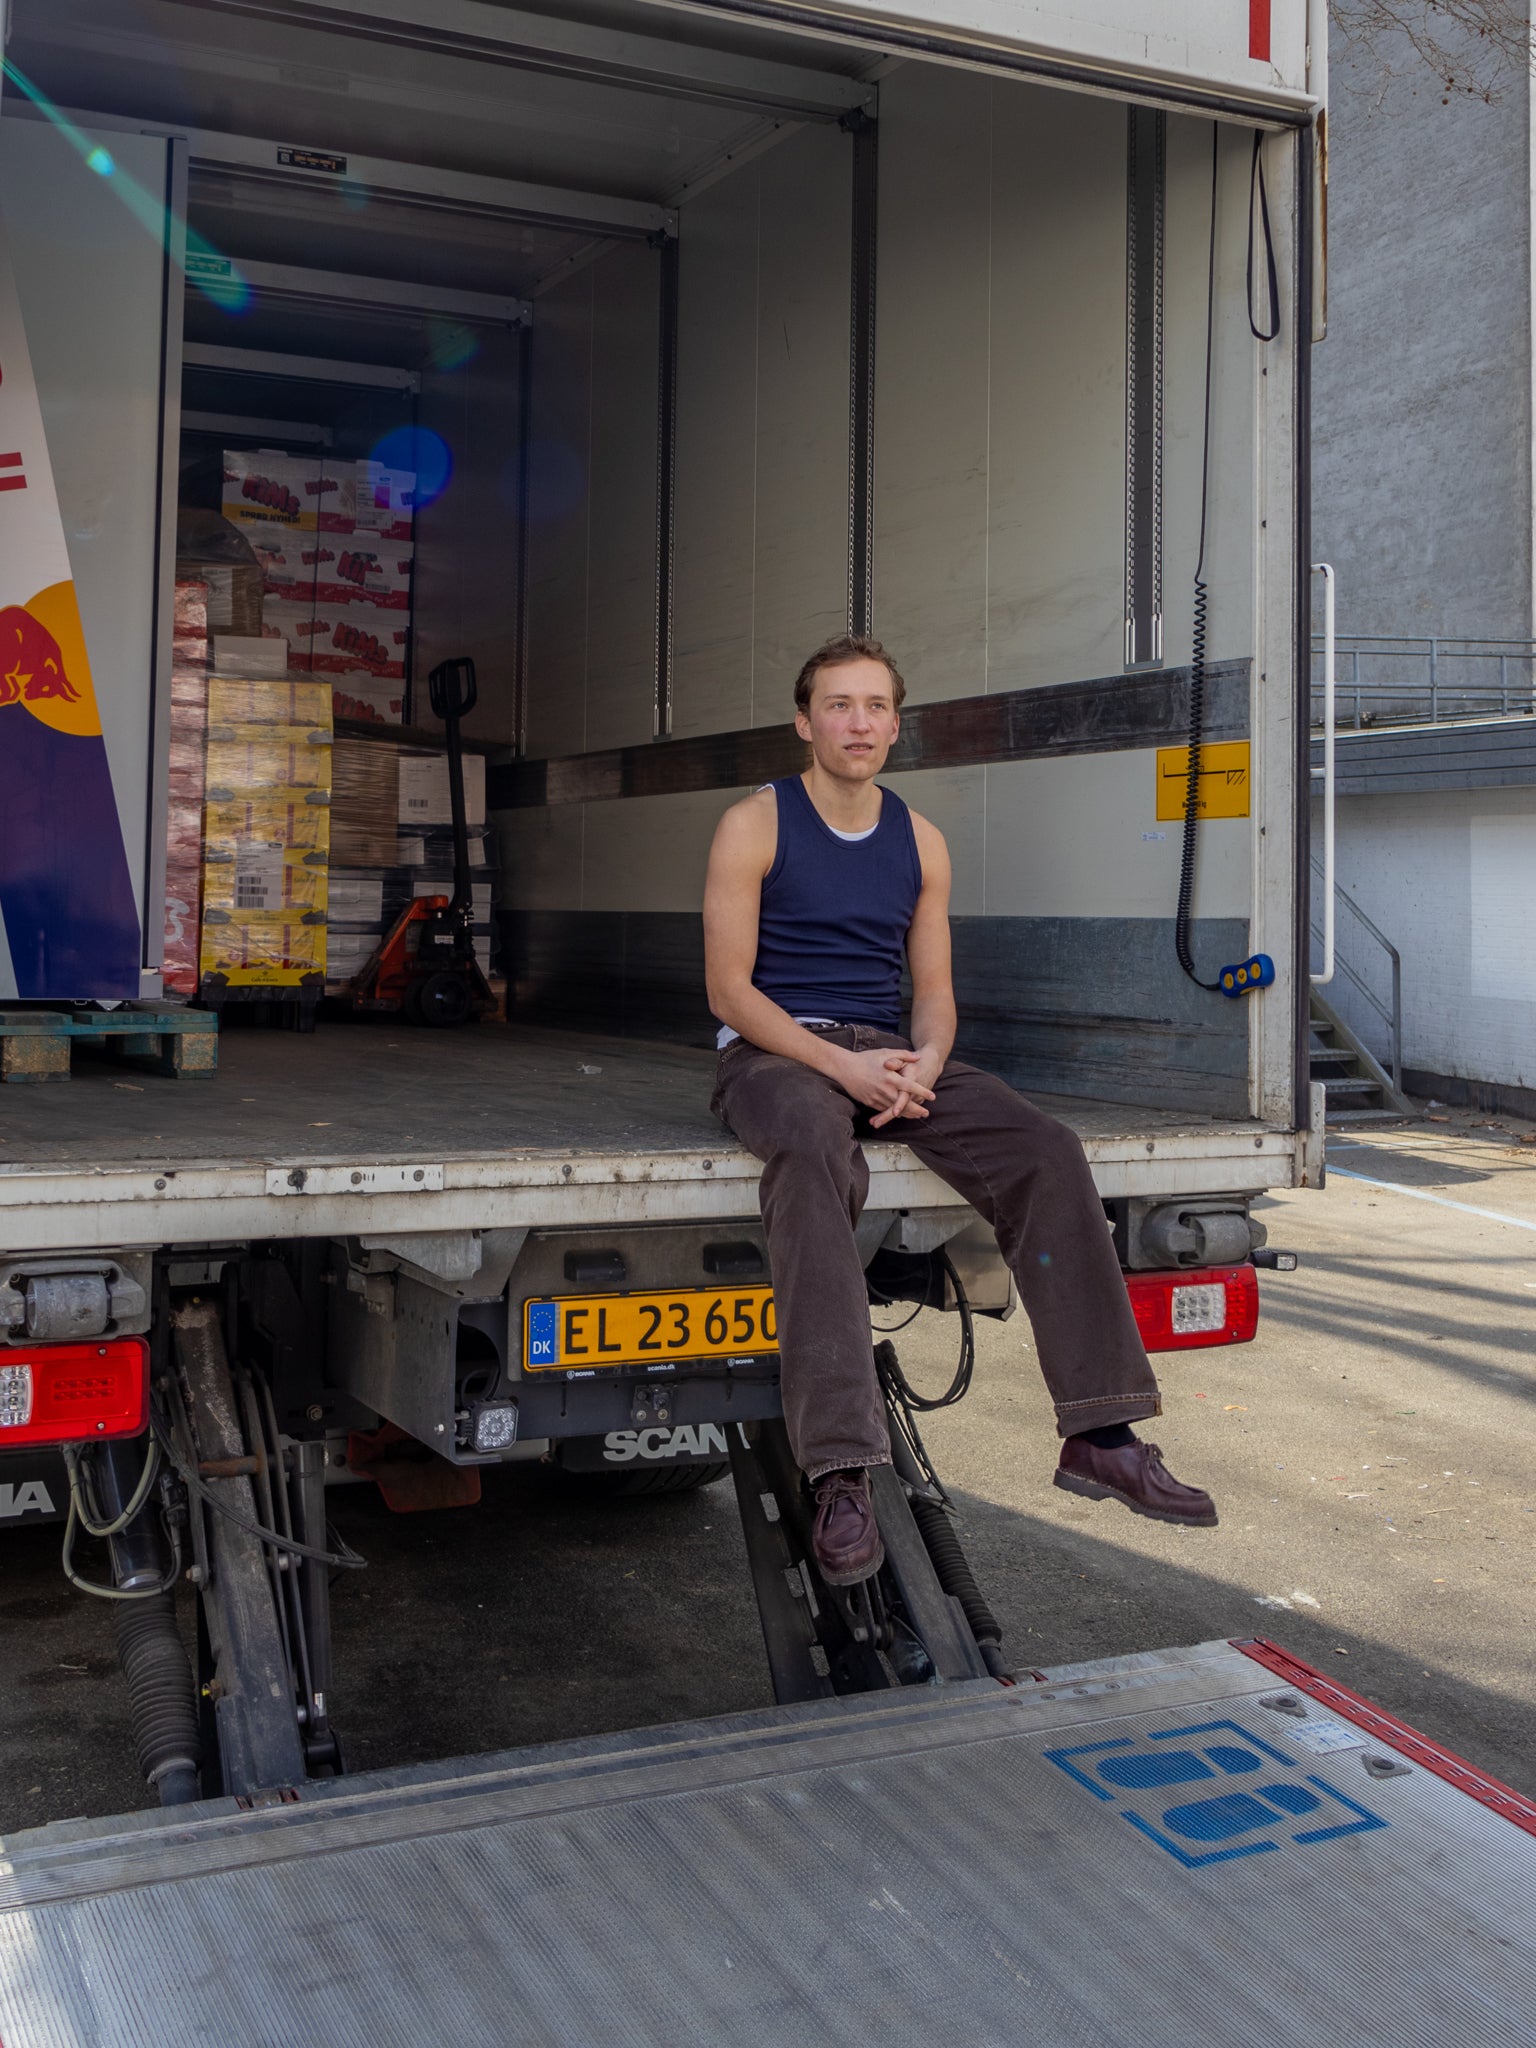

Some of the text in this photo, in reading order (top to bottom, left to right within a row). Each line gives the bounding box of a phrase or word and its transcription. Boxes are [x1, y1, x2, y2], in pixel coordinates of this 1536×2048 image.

[565, 1297, 778, 1354] EL 23 650
[533, 1340, 551, 1355] DK
[647, 1363, 675, 1371] scania.dk
[603, 1423, 750, 1461] SCAN
